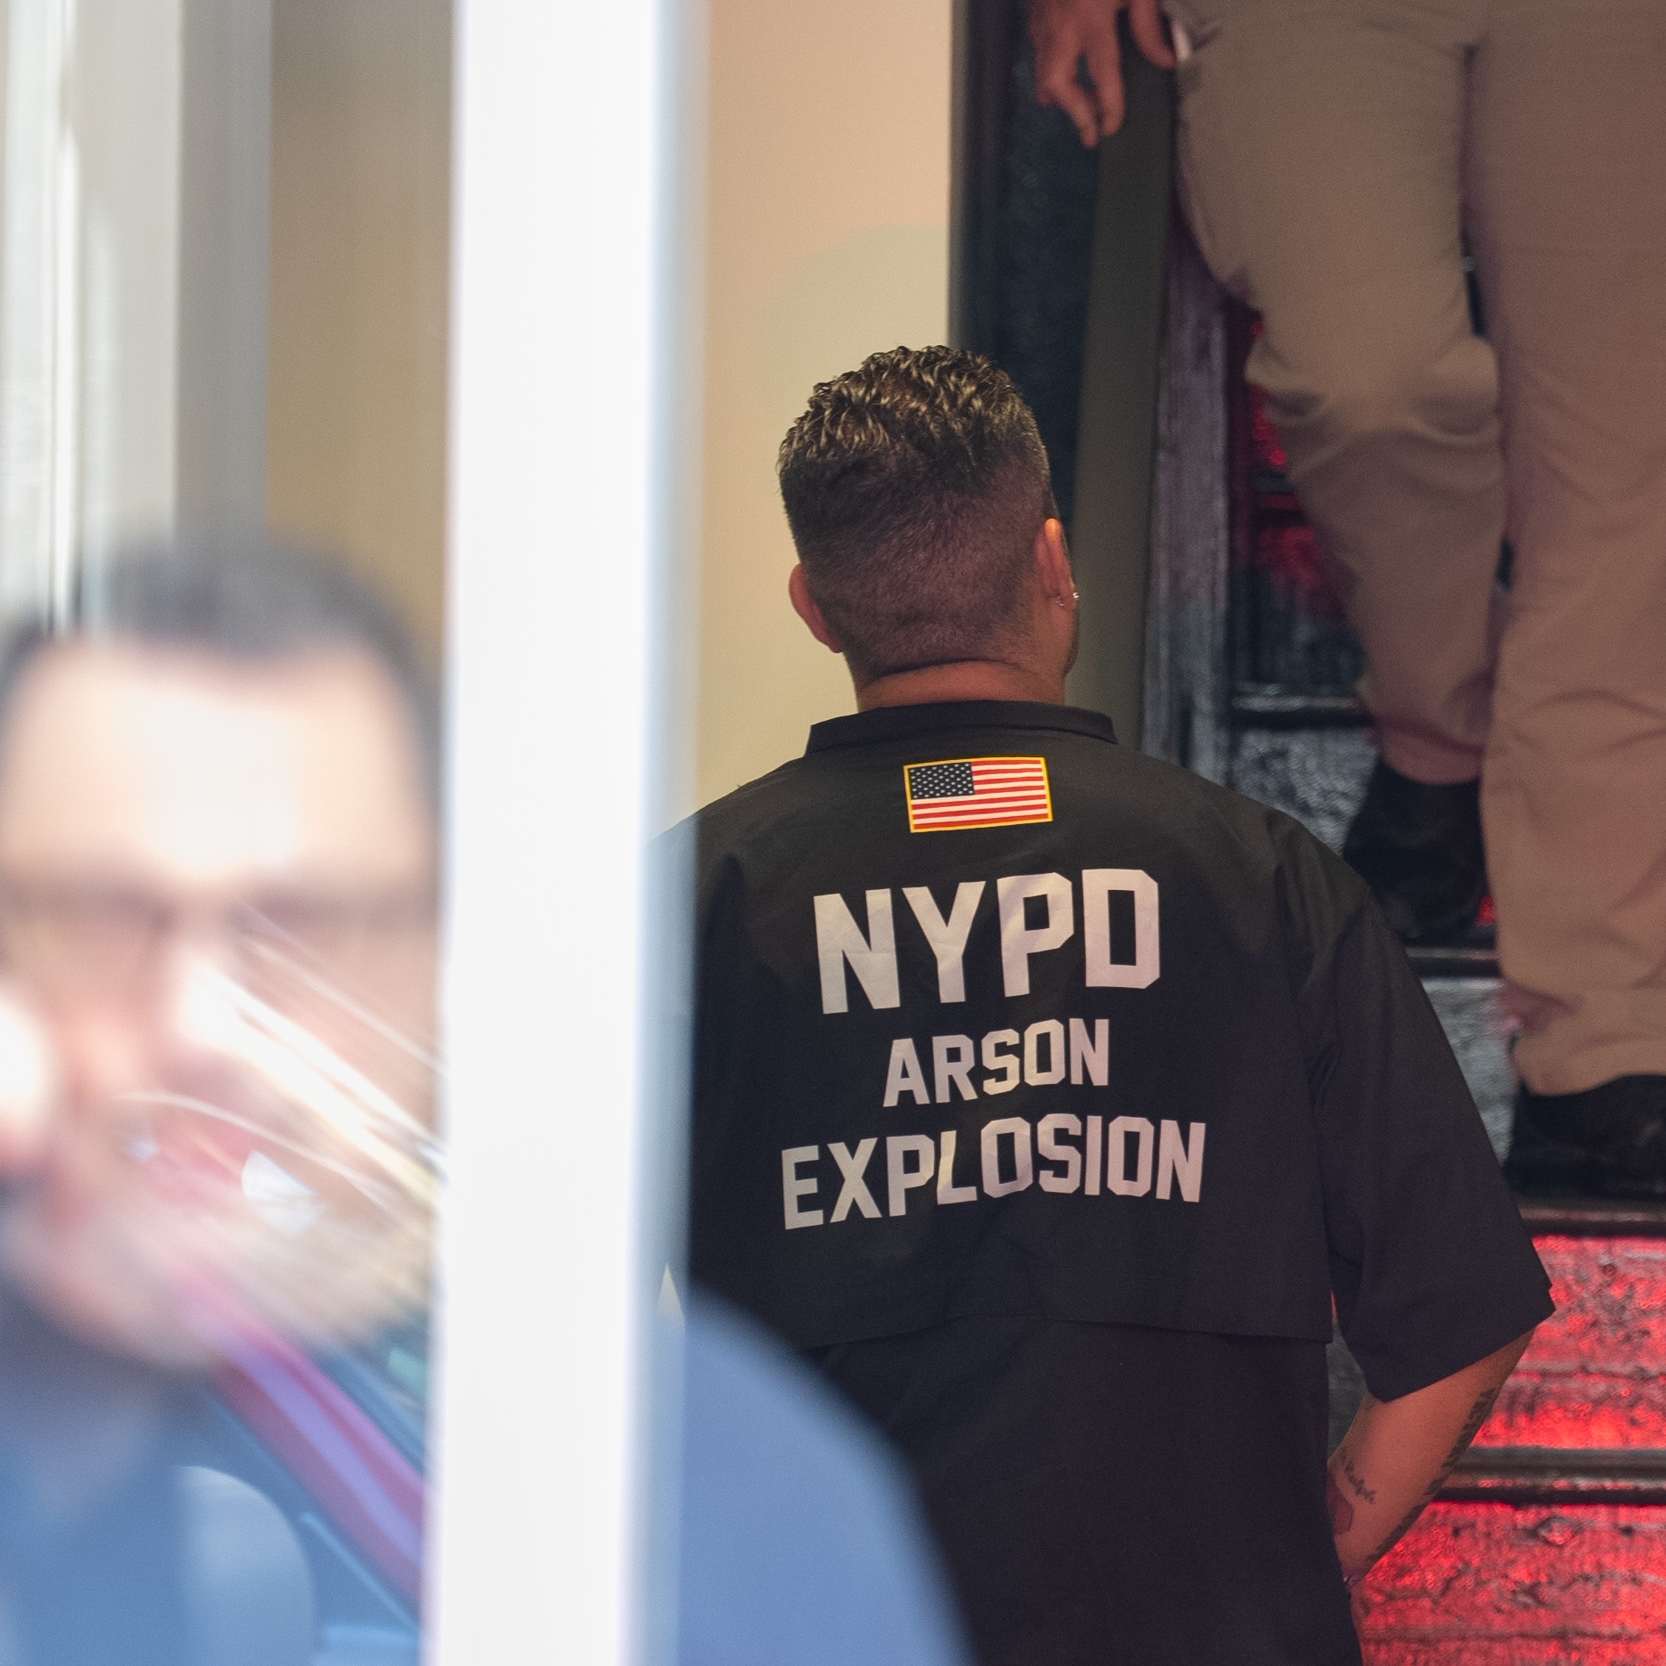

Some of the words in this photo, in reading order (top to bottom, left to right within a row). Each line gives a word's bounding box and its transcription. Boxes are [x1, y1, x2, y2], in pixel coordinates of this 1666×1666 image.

[813, 867, 1161, 1015] NYPD
[883, 1017, 1110, 1108] ARSON
[781, 1113, 1207, 1231] EXPLOSION
